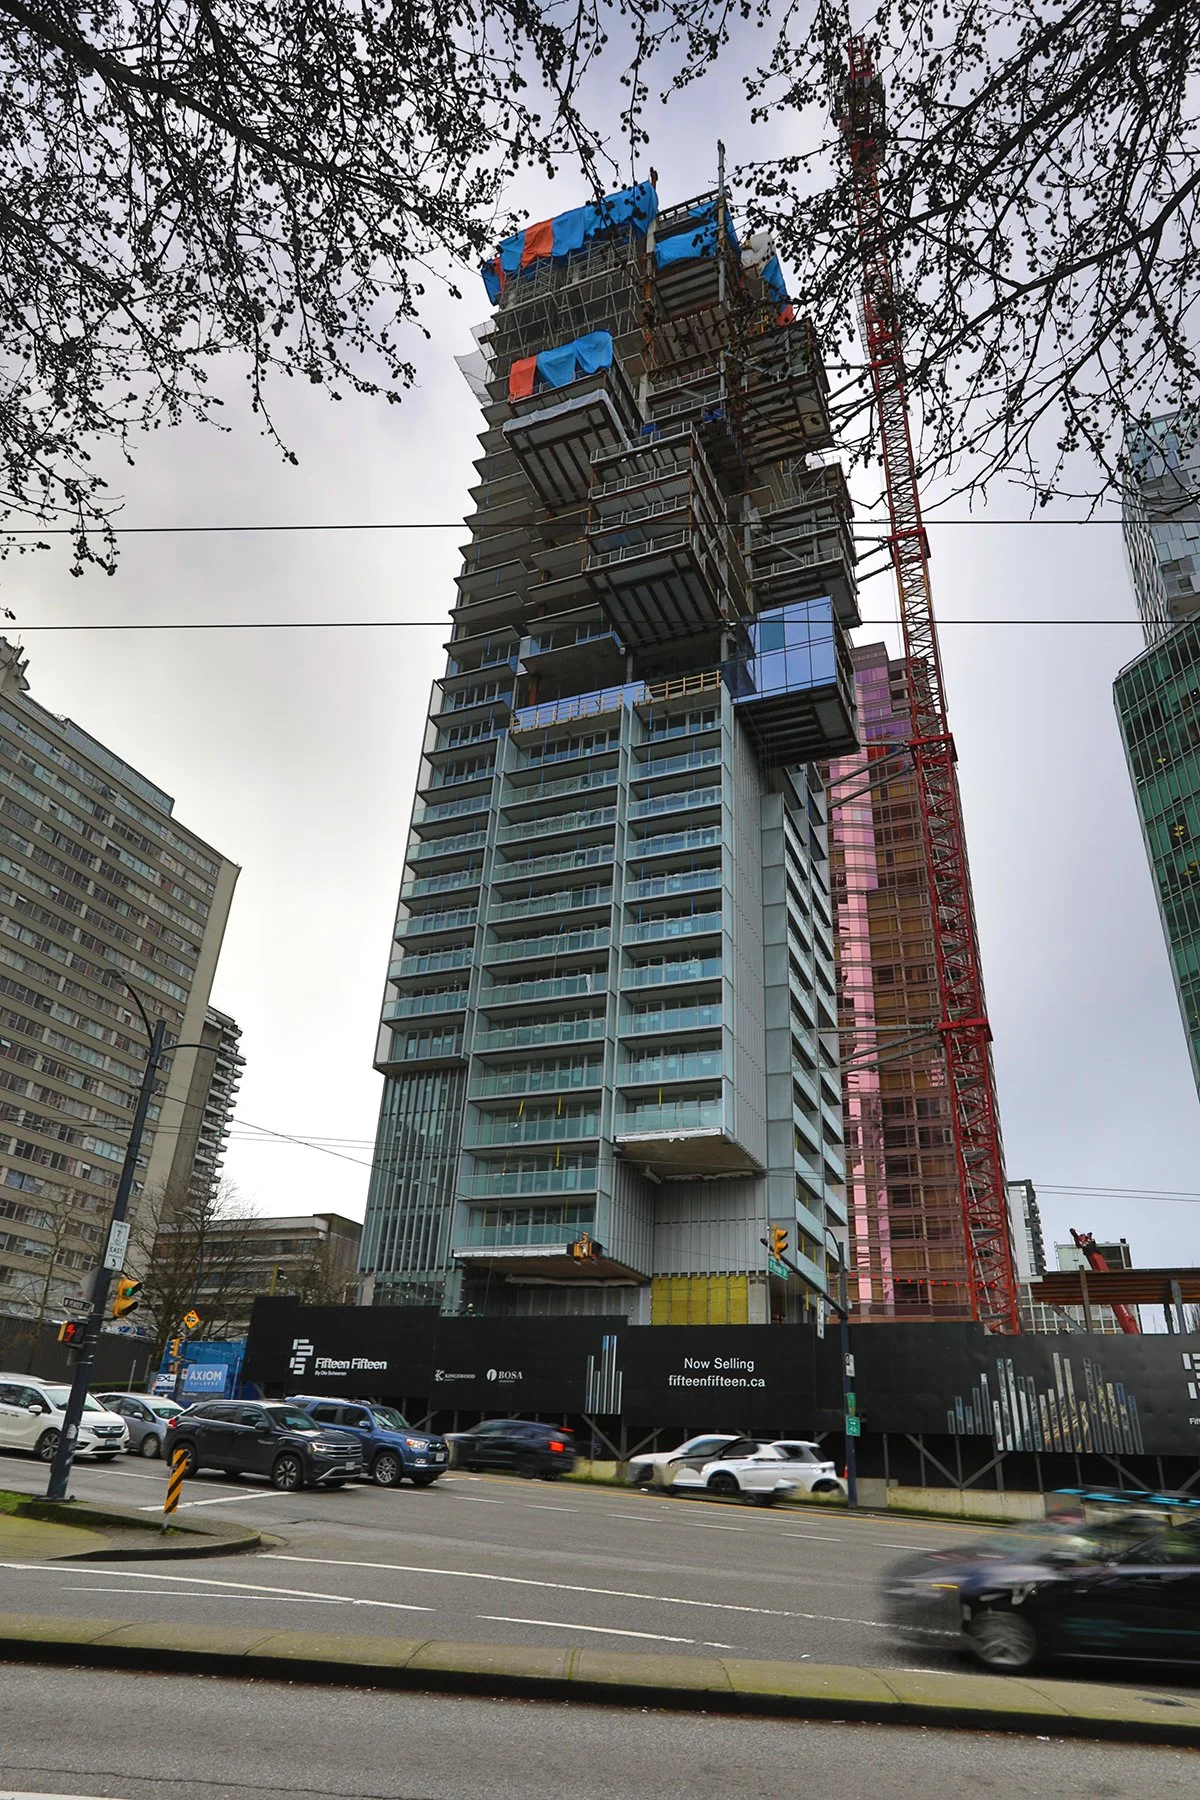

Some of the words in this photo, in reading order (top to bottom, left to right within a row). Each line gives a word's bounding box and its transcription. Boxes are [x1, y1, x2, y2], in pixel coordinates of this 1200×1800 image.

[109, 1246, 123, 1254] EAST
[315, 1357, 350, 1369] Fifteen
[351, 1358, 387, 1370] Fifteen
[684, 1357, 710, 1369] Now
[714, 1357, 755, 1373] Selling
[189, 1370, 222, 1381] AXIOM
[498, 1371, 523, 1380] BOSA
[668, 1375, 766, 1387] fifteenfifteen.ca
